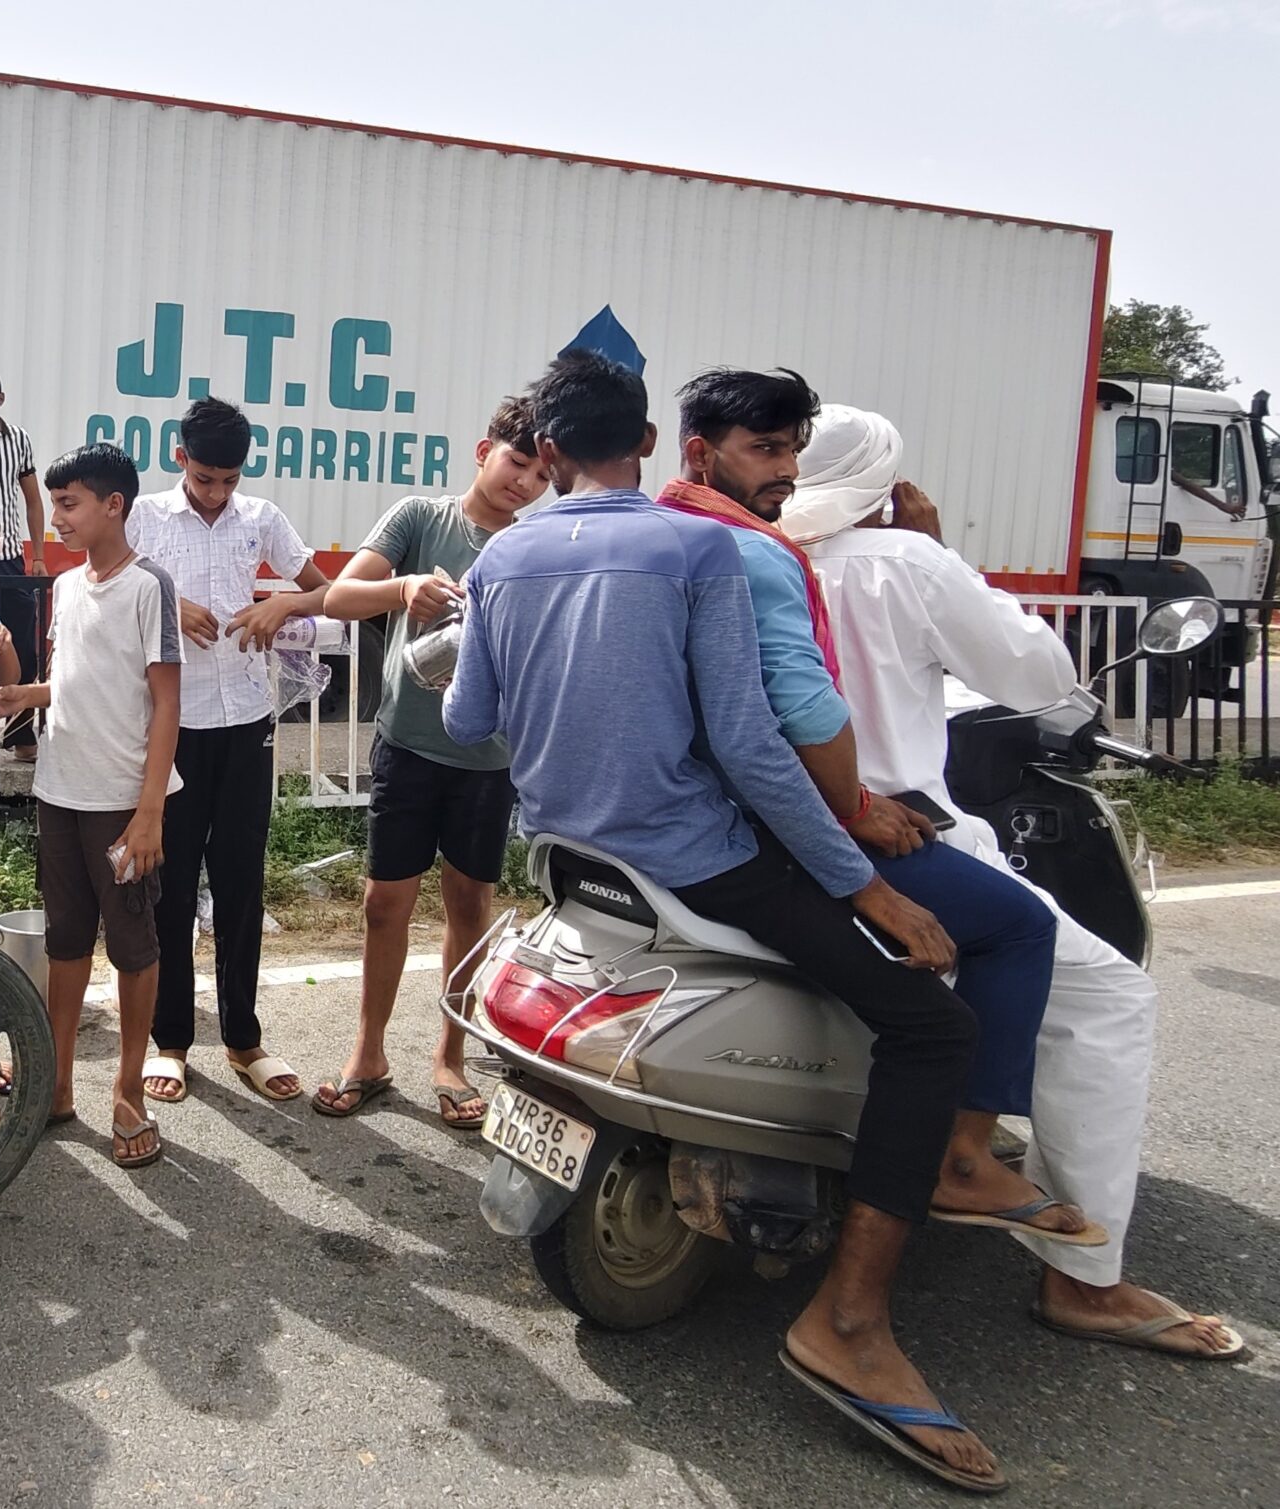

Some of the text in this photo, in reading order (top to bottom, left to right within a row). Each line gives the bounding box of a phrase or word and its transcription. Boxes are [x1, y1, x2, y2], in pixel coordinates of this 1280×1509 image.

[86, 413, 450, 488] COO CARRIER
[578, 879, 632, 906] HONDA
[704, 1047, 824, 1074] Activa
[508, 1094, 568, 1143] HR36
[492, 1116, 577, 1182] AD0968
